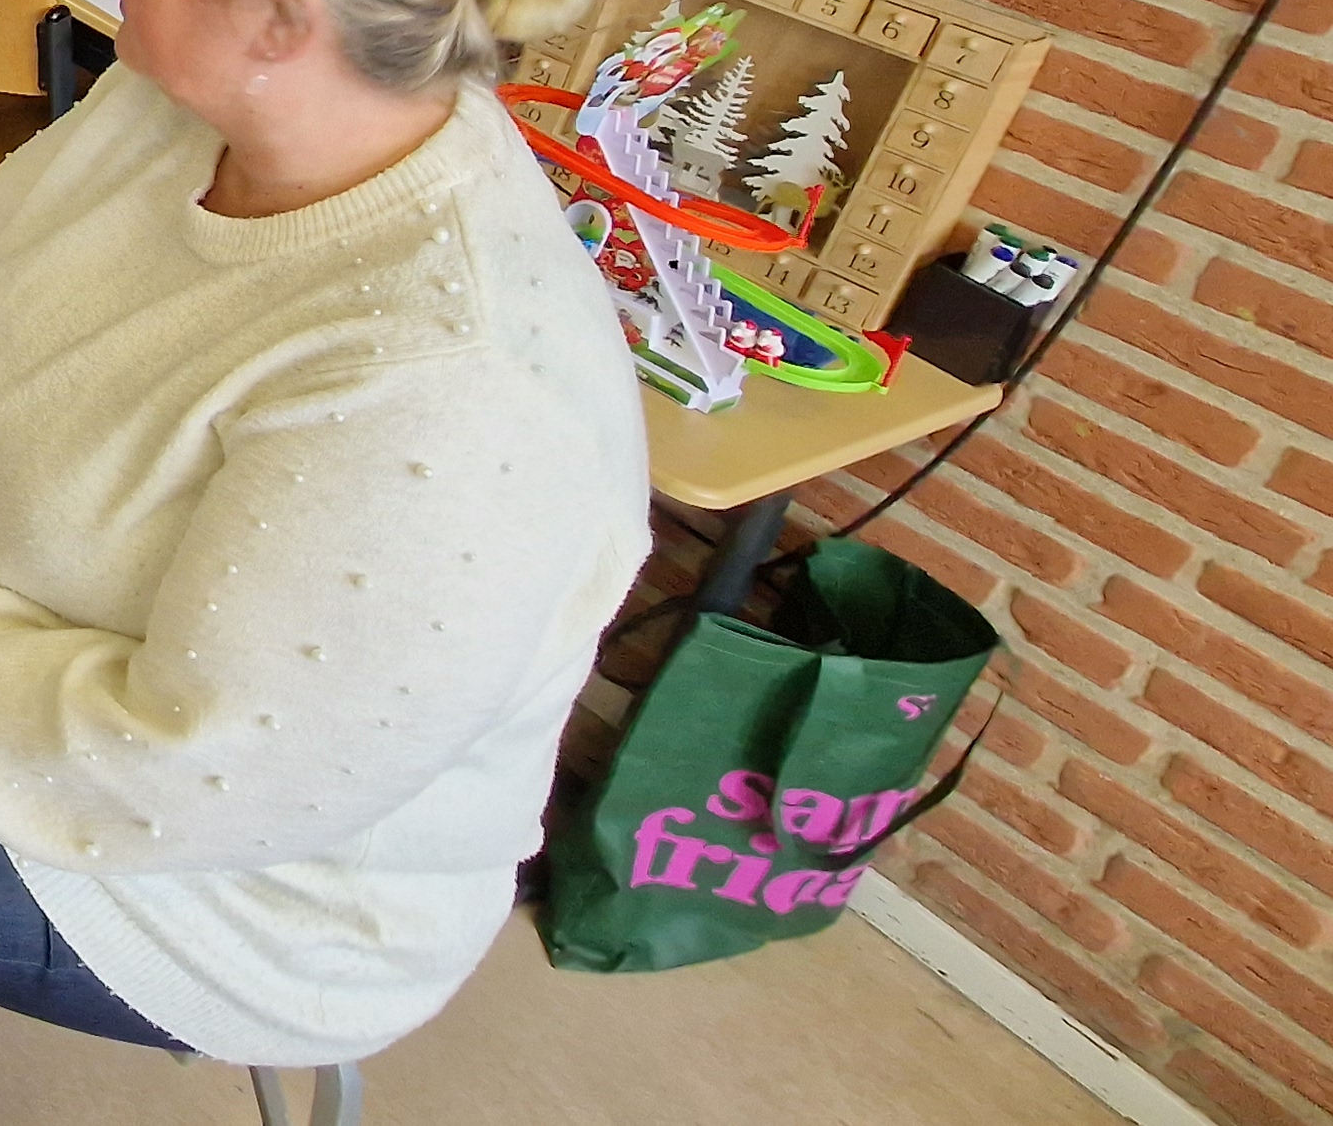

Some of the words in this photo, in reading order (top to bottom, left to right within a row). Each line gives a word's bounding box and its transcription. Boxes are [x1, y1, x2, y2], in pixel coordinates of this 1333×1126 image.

[881, 20, 907, 41] 6
[955, 44, 980, 65] 7
[933, 89, 955, 110] 8
[910, 129, 931, 150] 9
[886, 171, 918, 196] 10
[865, 212, 891, 237] 11
